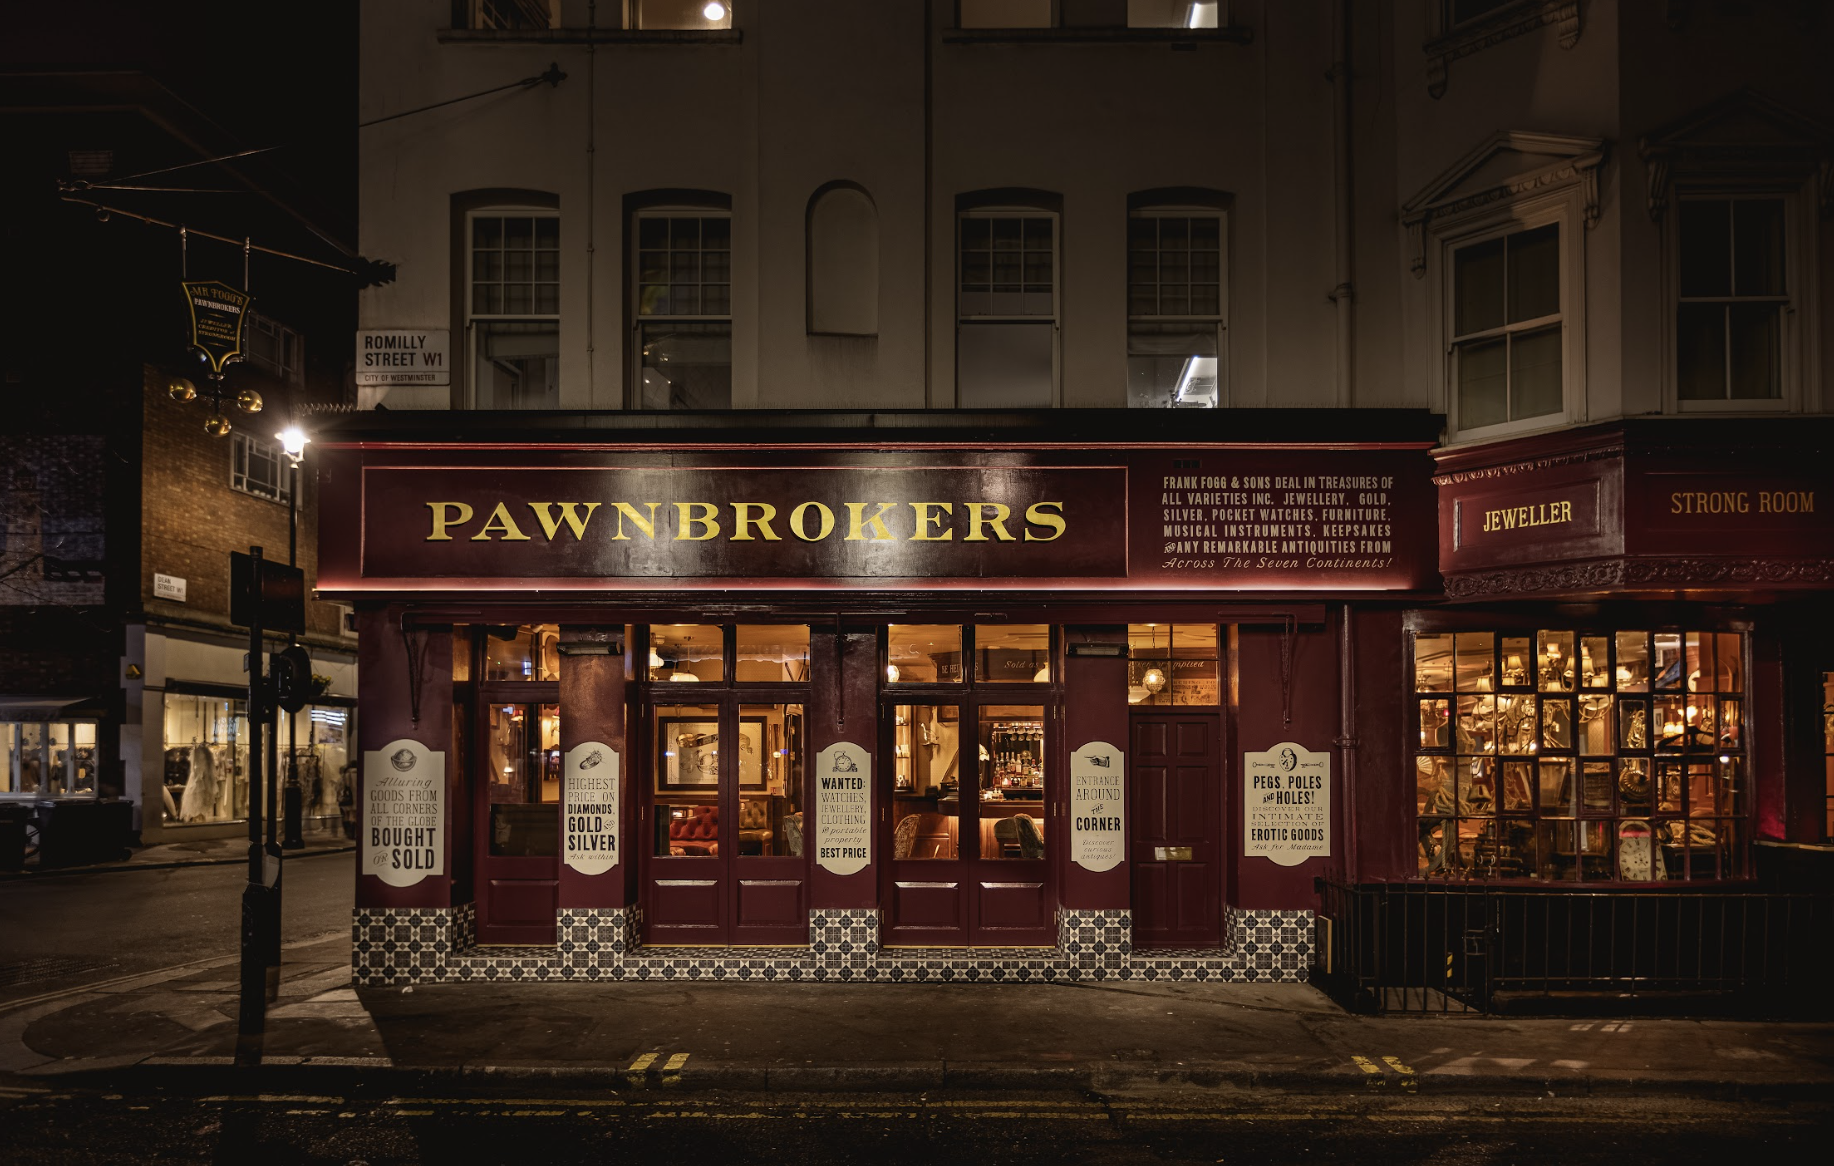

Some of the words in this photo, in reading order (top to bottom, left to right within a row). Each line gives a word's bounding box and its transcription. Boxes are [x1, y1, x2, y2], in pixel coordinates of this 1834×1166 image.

[190, 286, 210, 297] MR
[194, 297, 241, 314] PAWNBROKERS
[365, 335, 426, 349] ROMILLY
[365, 352, 417, 366] STREET
[423, 352, 442, 366] W1
[364, 374, 379, 382] CITY
[381, 374, 389, 382] OF
[391, 374, 436, 382] WESTMINSTER
[1163, 476, 1197, 489] FRANK
[1201, 476, 1227, 489] FOGG
[1230, 476, 1240, 489] &
[1243, 476, 1270, 489] SONS
[1275, 476, 1301, 489] DEAL
[1303, 476, 1316, 489] IN
[1318, 476, 1378, 489] TREASURES
[1381, 476, 1394, 489] OF
[1161, 493, 1182, 505] ALL
[1187, 493, 1248, 505] VARIETIES
[1252, 493, 1274, 505] INC.
[1283, 493, 1349, 506] JEWELLERY,
[1359, 493, 1391, 506] GOLD,
[1671, 492, 1749, 514] STRONG
[1758, 491, 1814, 513] ROOM
[425, 501, 1067, 542] PAWNBROKERS
[1163, 509, 1208, 522] SILVER,
[1212, 509, 1255, 521] POCKET
[1260, 509, 1318, 522] WATCHES,
[1322, 509, 1391, 522] FURNITURE,
[1483, 501, 1572, 532] JEWELLER
[1163, 525, 1217, 537] MUSICAL
[1224, 525, 1316, 538] INSTRUMENTS,
[1323, 525, 1391, 537] KEEPSAKES
[1164, 542, 1176, 554] AND
[1176, 541, 1199, 553] ANY
[1203, 541, 1278, 553] REMARKABLE
[1282, 541, 1356, 555] ANTIQUITIES
[1360, 541, 1391, 553] FROM
[1161, 557, 1215, 569] Across
[1223, 557, 1251, 568] The
[1256, 557, 1298, 569] Seven
[1306, 557, 1393, 568] Continents!
[158, 576, 171, 584] DEAN
[157, 583, 176, 592] STREET
[375, 777, 433, 789] Alluring
[568, 777, 616, 790] HIGHEST
[821, 777, 866, 790] WANTED:
[1076, 776, 1120, 785] ENTRANCE
[1288, 775, 1322, 789] POLES
[370, 790, 404, 802] GOODS
[409, 790, 438, 802] FROM
[568, 791, 595, 802] PRICE
[602, 791, 615, 802] ON
[821, 792, 867, 804] WATCHES,
[1076, 788, 1121, 800] AROUND
[1263, 792, 1275, 804] AND
[1276, 791, 1315, 804] HOLES!
[370, 803, 389, 815] ALL
[393, 803, 438, 815] CORNERS
[821, 805, 867, 814] JEWELLERY,
[1091, 803, 1104, 815] THE
[371, 816, 382, 826] OF
[386, 816, 404, 826] THE
[408, 816, 437, 826] GLOBE
[568, 816, 602, 833] GOLD
[821, 815, 866, 825] CLOTHING
[1076, 817, 1121, 831] CORNER
[830, 826, 867, 835] portable
[1251, 829, 1288, 841] EROTIC
[1290, 829, 1324, 841] GOODS
[371, 827, 436, 847] BOUGHT
[568, 834, 615, 851] SILVER
[824, 836, 862, 845] property
[820, 847, 841, 858] BEST
[842, 847, 867, 858] PRICE
[391, 848, 435, 870] SOLD
